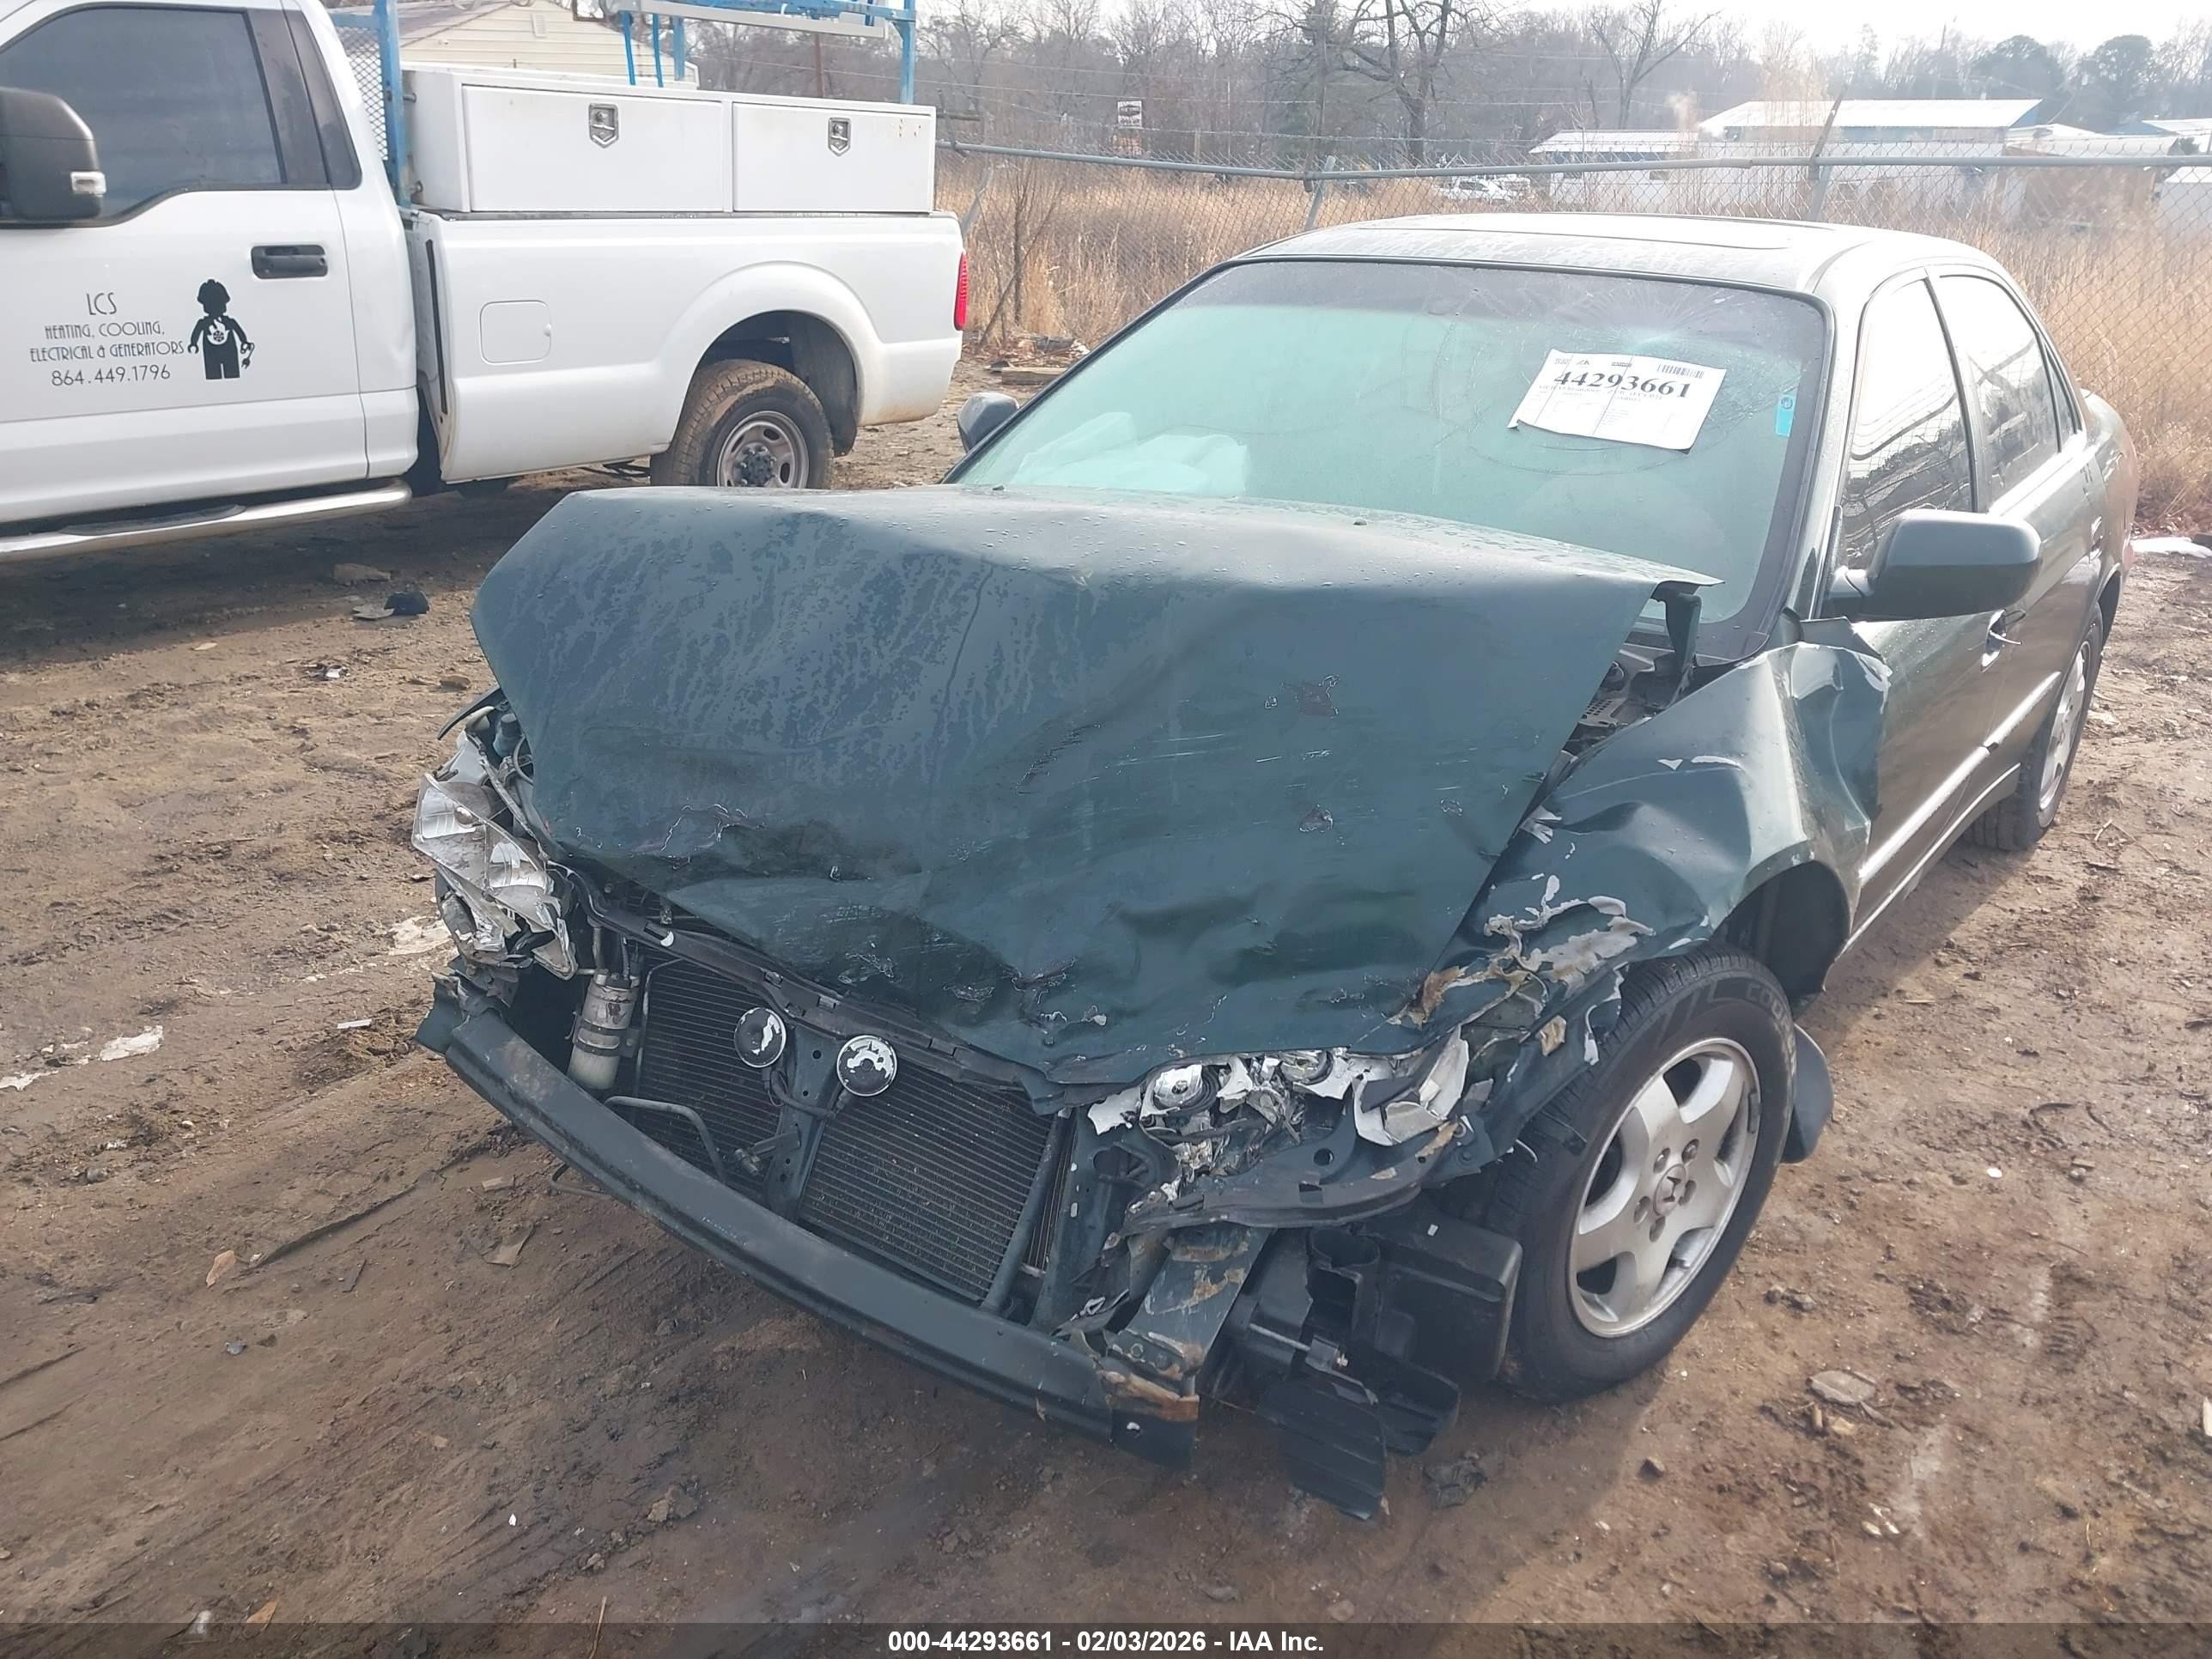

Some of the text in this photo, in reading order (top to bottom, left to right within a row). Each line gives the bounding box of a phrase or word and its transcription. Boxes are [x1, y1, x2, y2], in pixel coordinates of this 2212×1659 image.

[86, 292, 118, 315] LCS
[99, 320, 166, 337] COOLING,
[30, 345, 94, 362] ELECTRICAL
[110, 341, 185, 358] GENERATORS
[52, 363, 171, 386] 864.449.1796
[1553, 371, 1692, 398] 44293661
